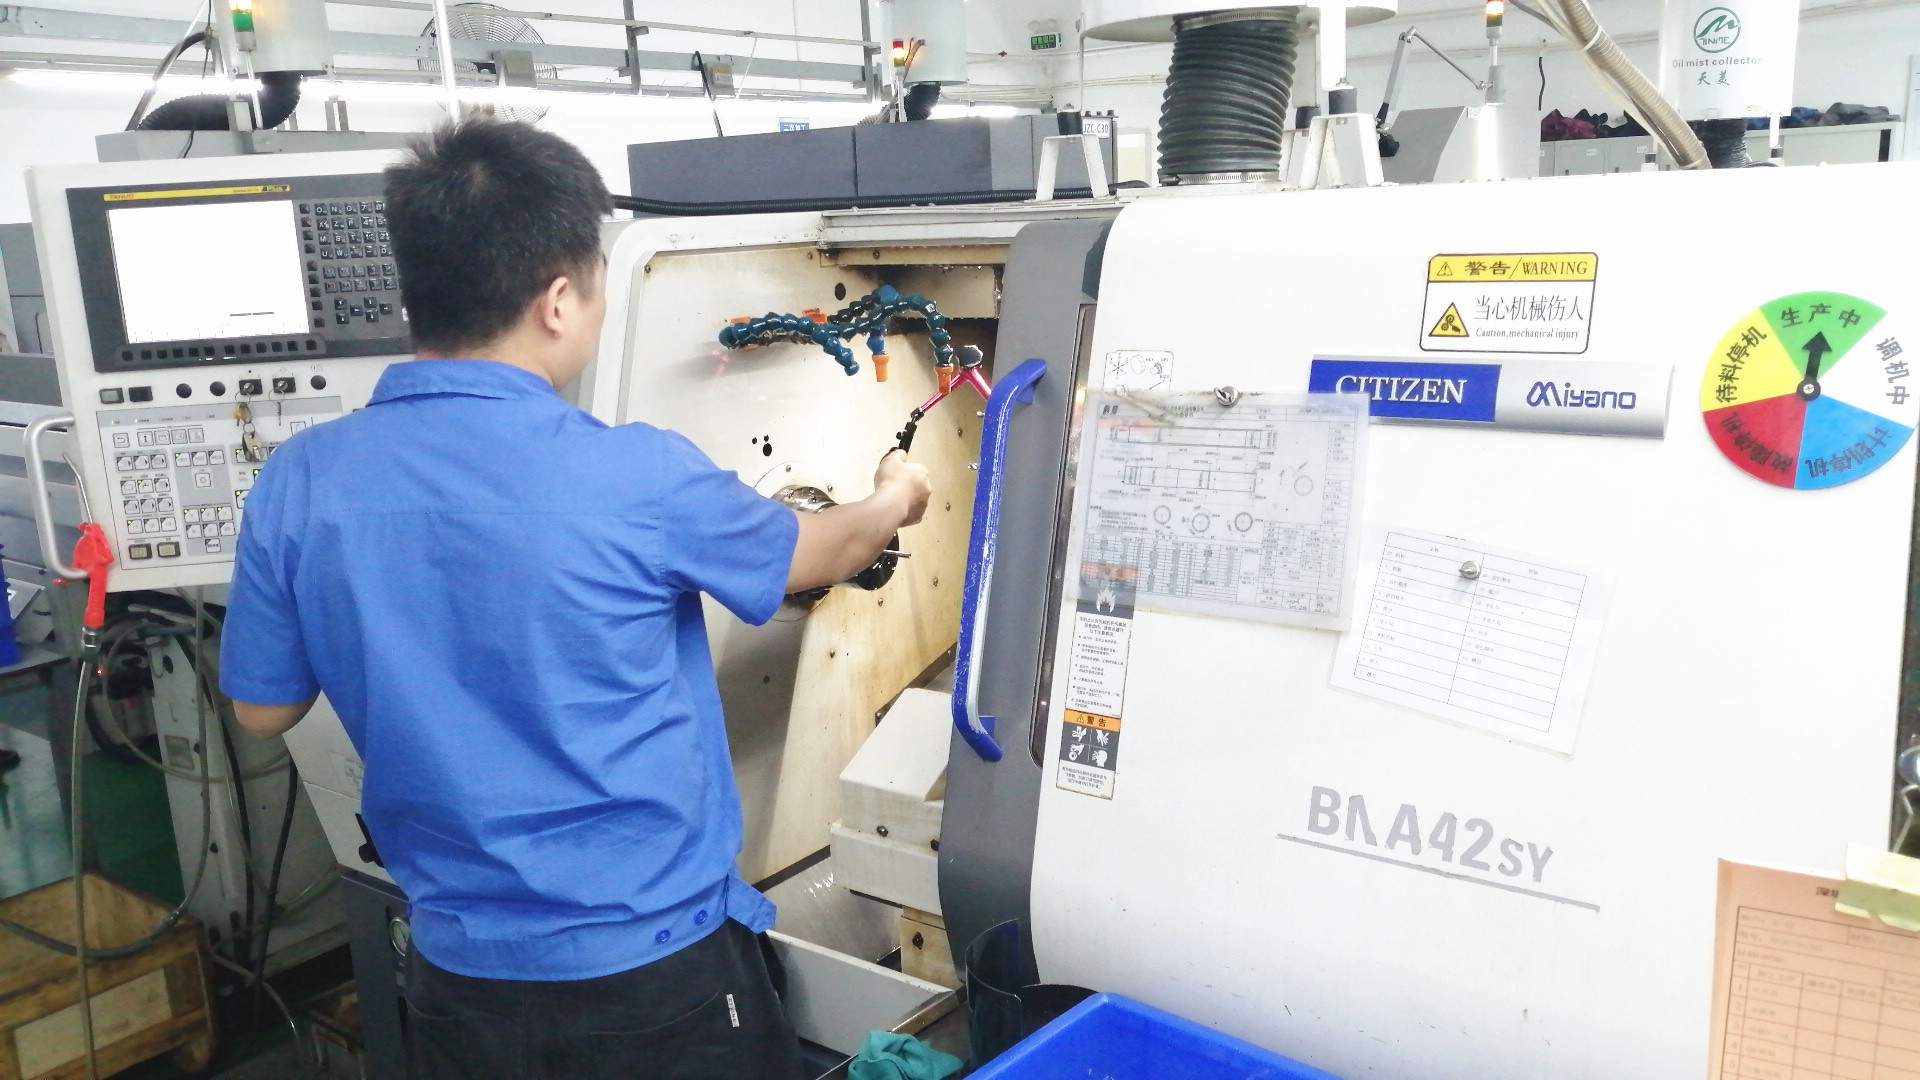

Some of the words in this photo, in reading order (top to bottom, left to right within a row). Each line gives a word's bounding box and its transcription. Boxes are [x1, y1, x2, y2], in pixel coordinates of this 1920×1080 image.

[1672, 59, 1684, 68] Oil
[1686, 58, 1709, 67] mist
[1712, 56, 1763, 66] collector
[1474, 294, 1584, 322] 当心机械伤人
[1781, 303, 1861, 328] 生产中
[1555, 328, 1580, 341] injury
[1716, 326, 1767, 403] 待料停机
[1876, 336, 1911, 405] 调机中
[1335, 375, 1468, 405] CITIZEN
[1526, 380, 1637, 410] Miyano
